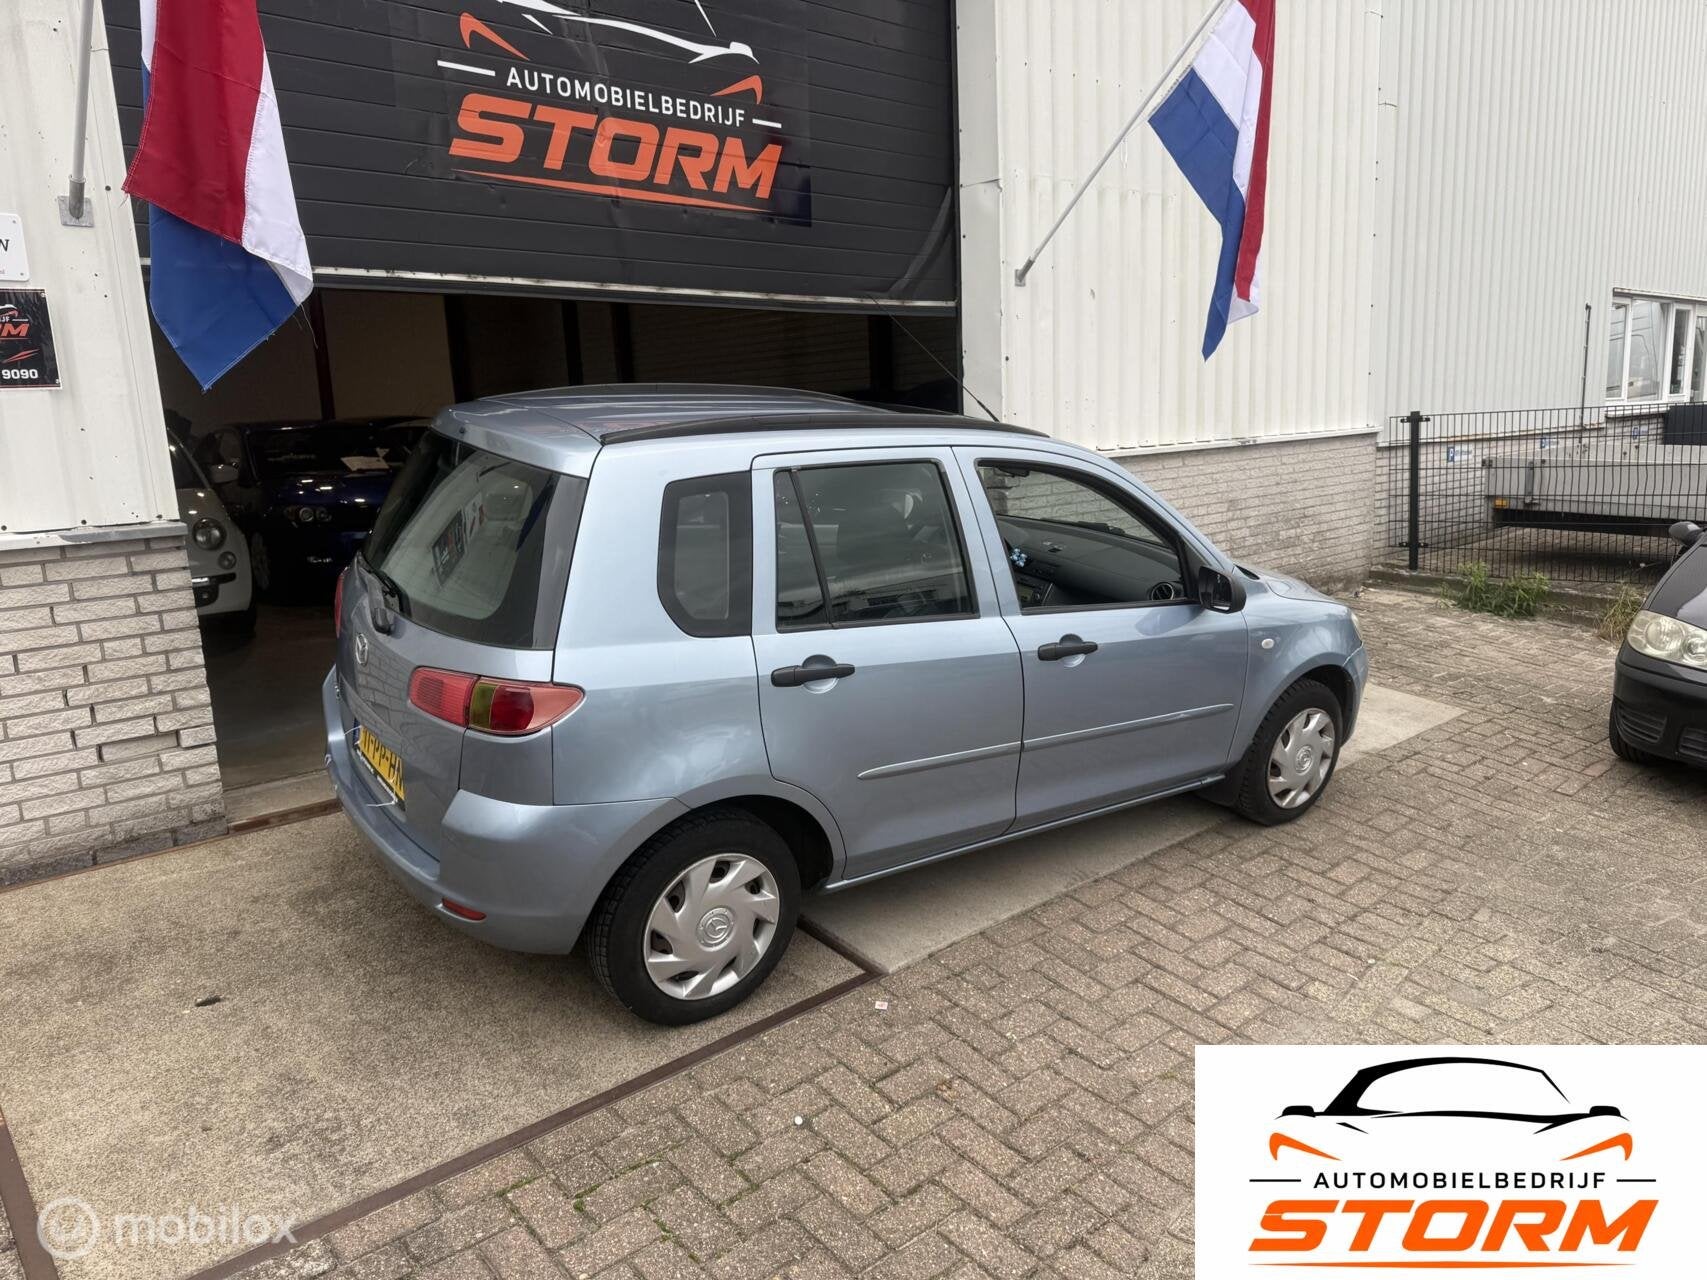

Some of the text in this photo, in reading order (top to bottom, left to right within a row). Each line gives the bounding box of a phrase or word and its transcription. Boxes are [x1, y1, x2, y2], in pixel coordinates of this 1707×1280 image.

[506, 67, 745, 128] AUTOMOBIELBEDRIJF
[449, 93, 783, 199] STORM
[1, 368, 39, 379] 9090
